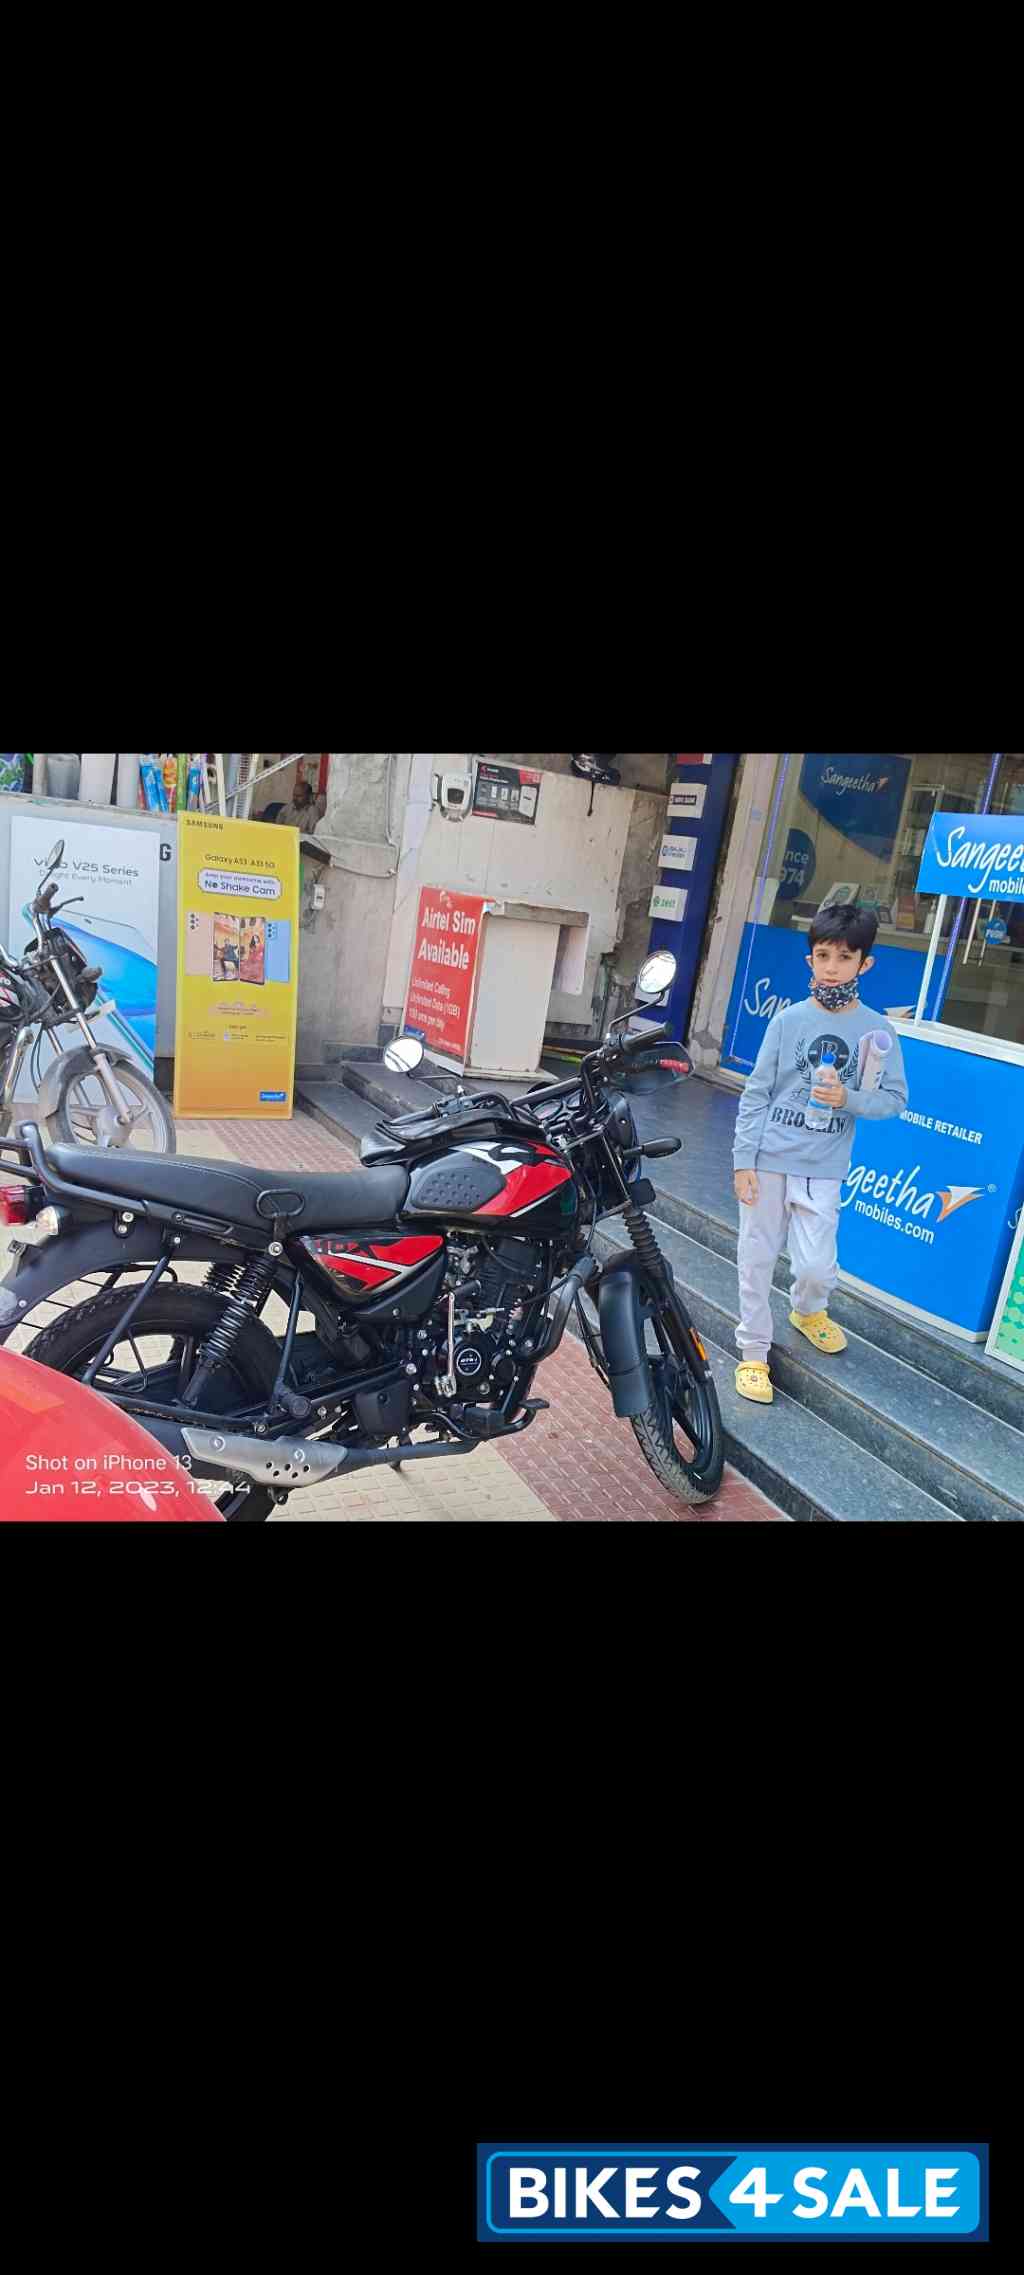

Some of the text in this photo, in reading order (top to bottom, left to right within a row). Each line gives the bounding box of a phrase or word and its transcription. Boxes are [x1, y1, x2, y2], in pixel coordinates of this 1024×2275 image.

[820, 766, 875, 796] Sangeetha
[186, 819, 224, 830] SAMSUNG
[73, 862, 98, 872] V25
[103, 865, 139, 877] Series
[204, 854, 232, 865] Galaxy
[221, 881, 249, 893] Shake
[252, 884, 276, 895] Cam
[422, 906, 476, 935] Airtel Sim
[418, 938, 470, 970] Available
[934, 1120, 983, 1145] RETAILER
[854, 1199, 935, 1245] mobiles.com
